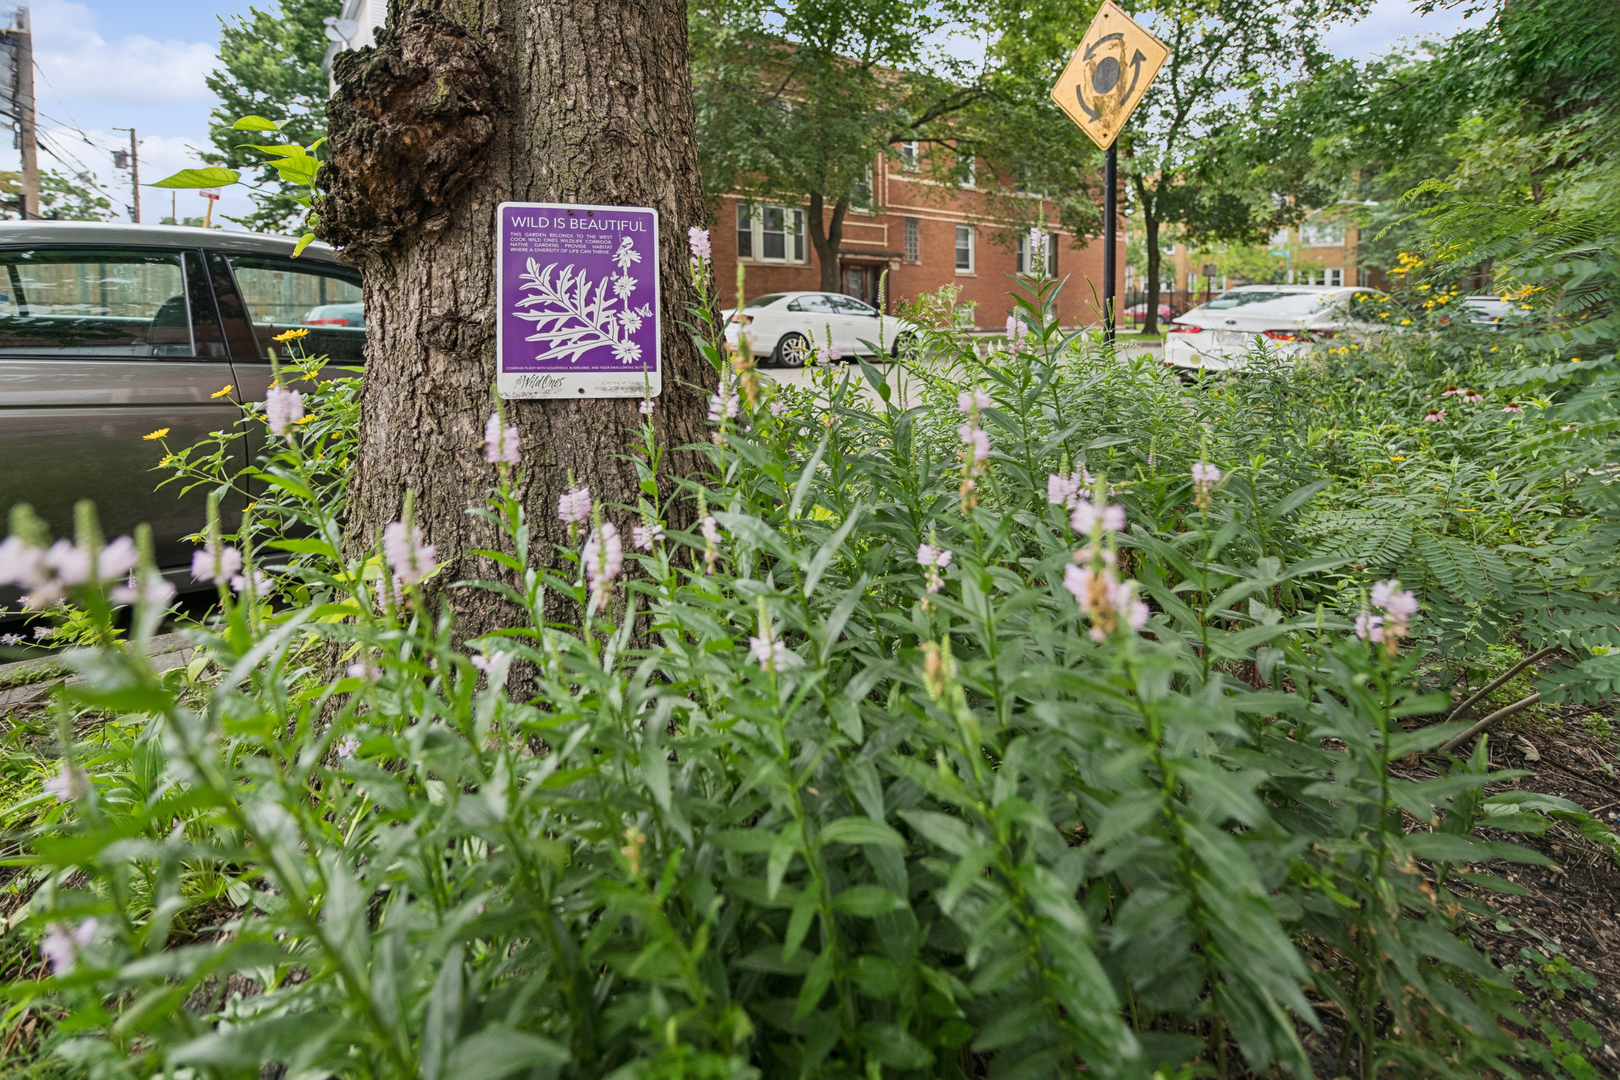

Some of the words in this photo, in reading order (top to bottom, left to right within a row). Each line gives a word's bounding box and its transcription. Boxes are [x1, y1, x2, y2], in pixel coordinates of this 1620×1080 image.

[511, 216, 550, 228] WILD
[554, 218, 566, 228] IS
[570, 218, 646, 232] BEAUTIFUL
